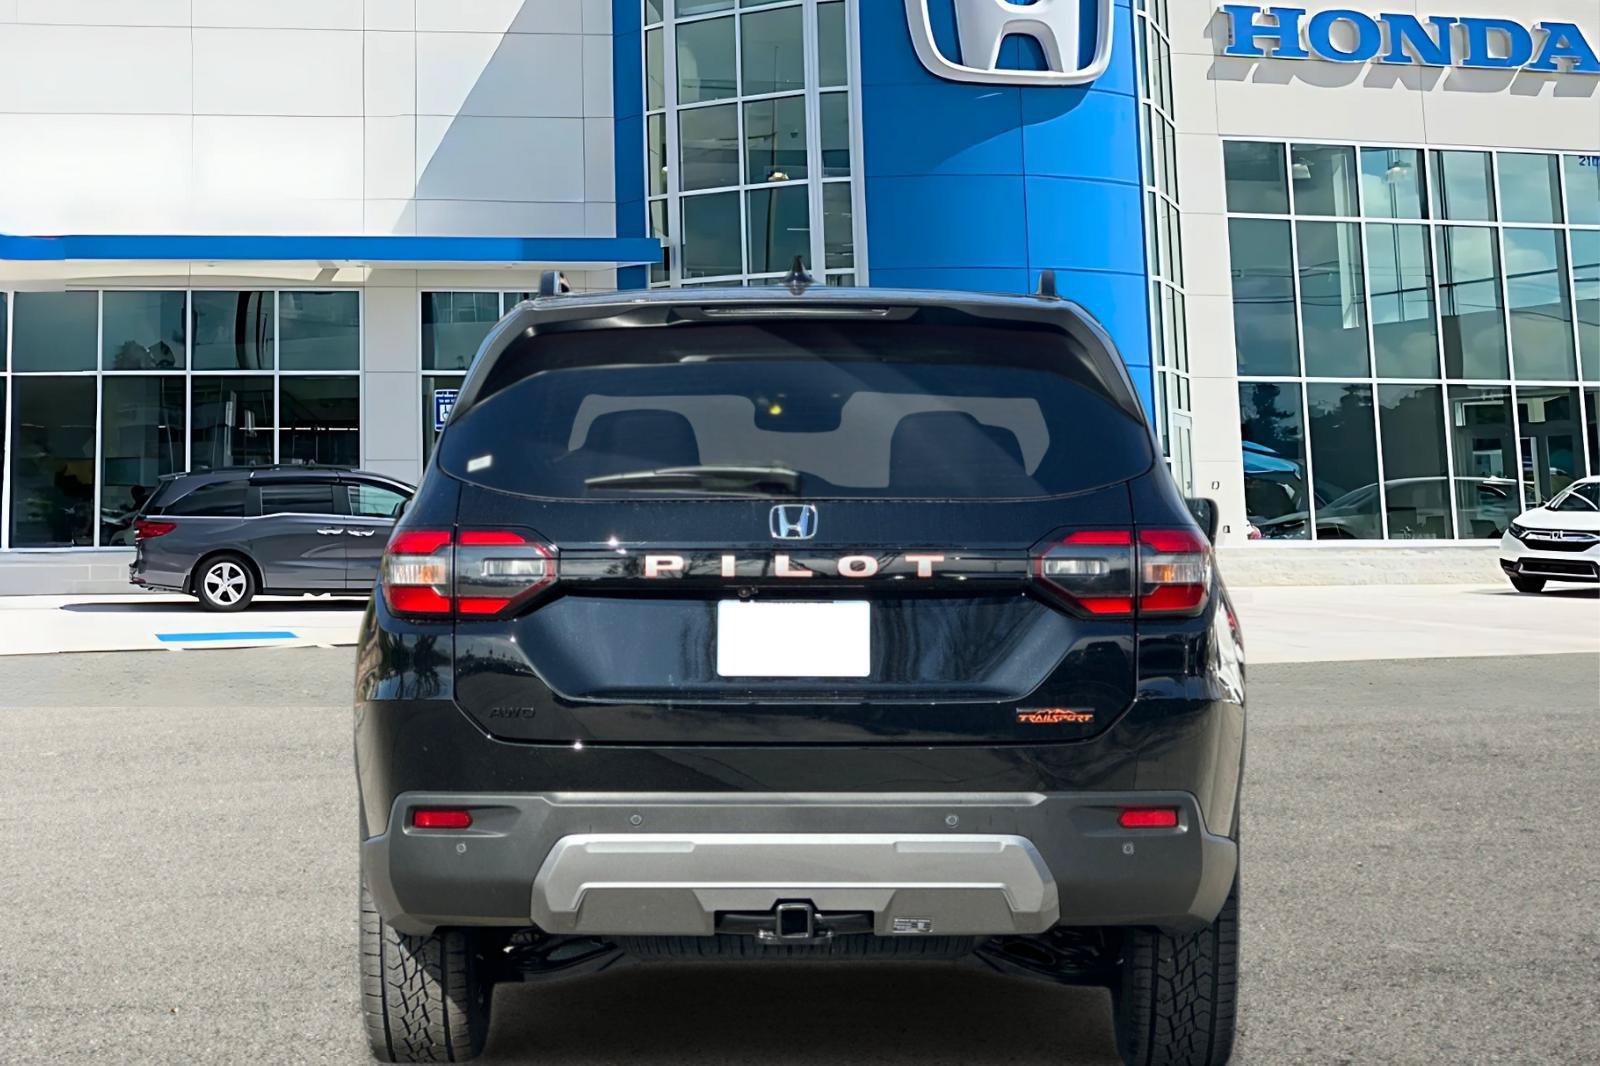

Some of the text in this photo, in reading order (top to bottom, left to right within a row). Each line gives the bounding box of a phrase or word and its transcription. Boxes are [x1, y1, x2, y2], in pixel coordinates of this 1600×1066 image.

[1223, 4, 1600, 72] HONDA
[644, 555, 945, 578] PILOT
[488, 706, 536, 719] AWD
[1017, 711, 1094, 723] TRAILSPORT
